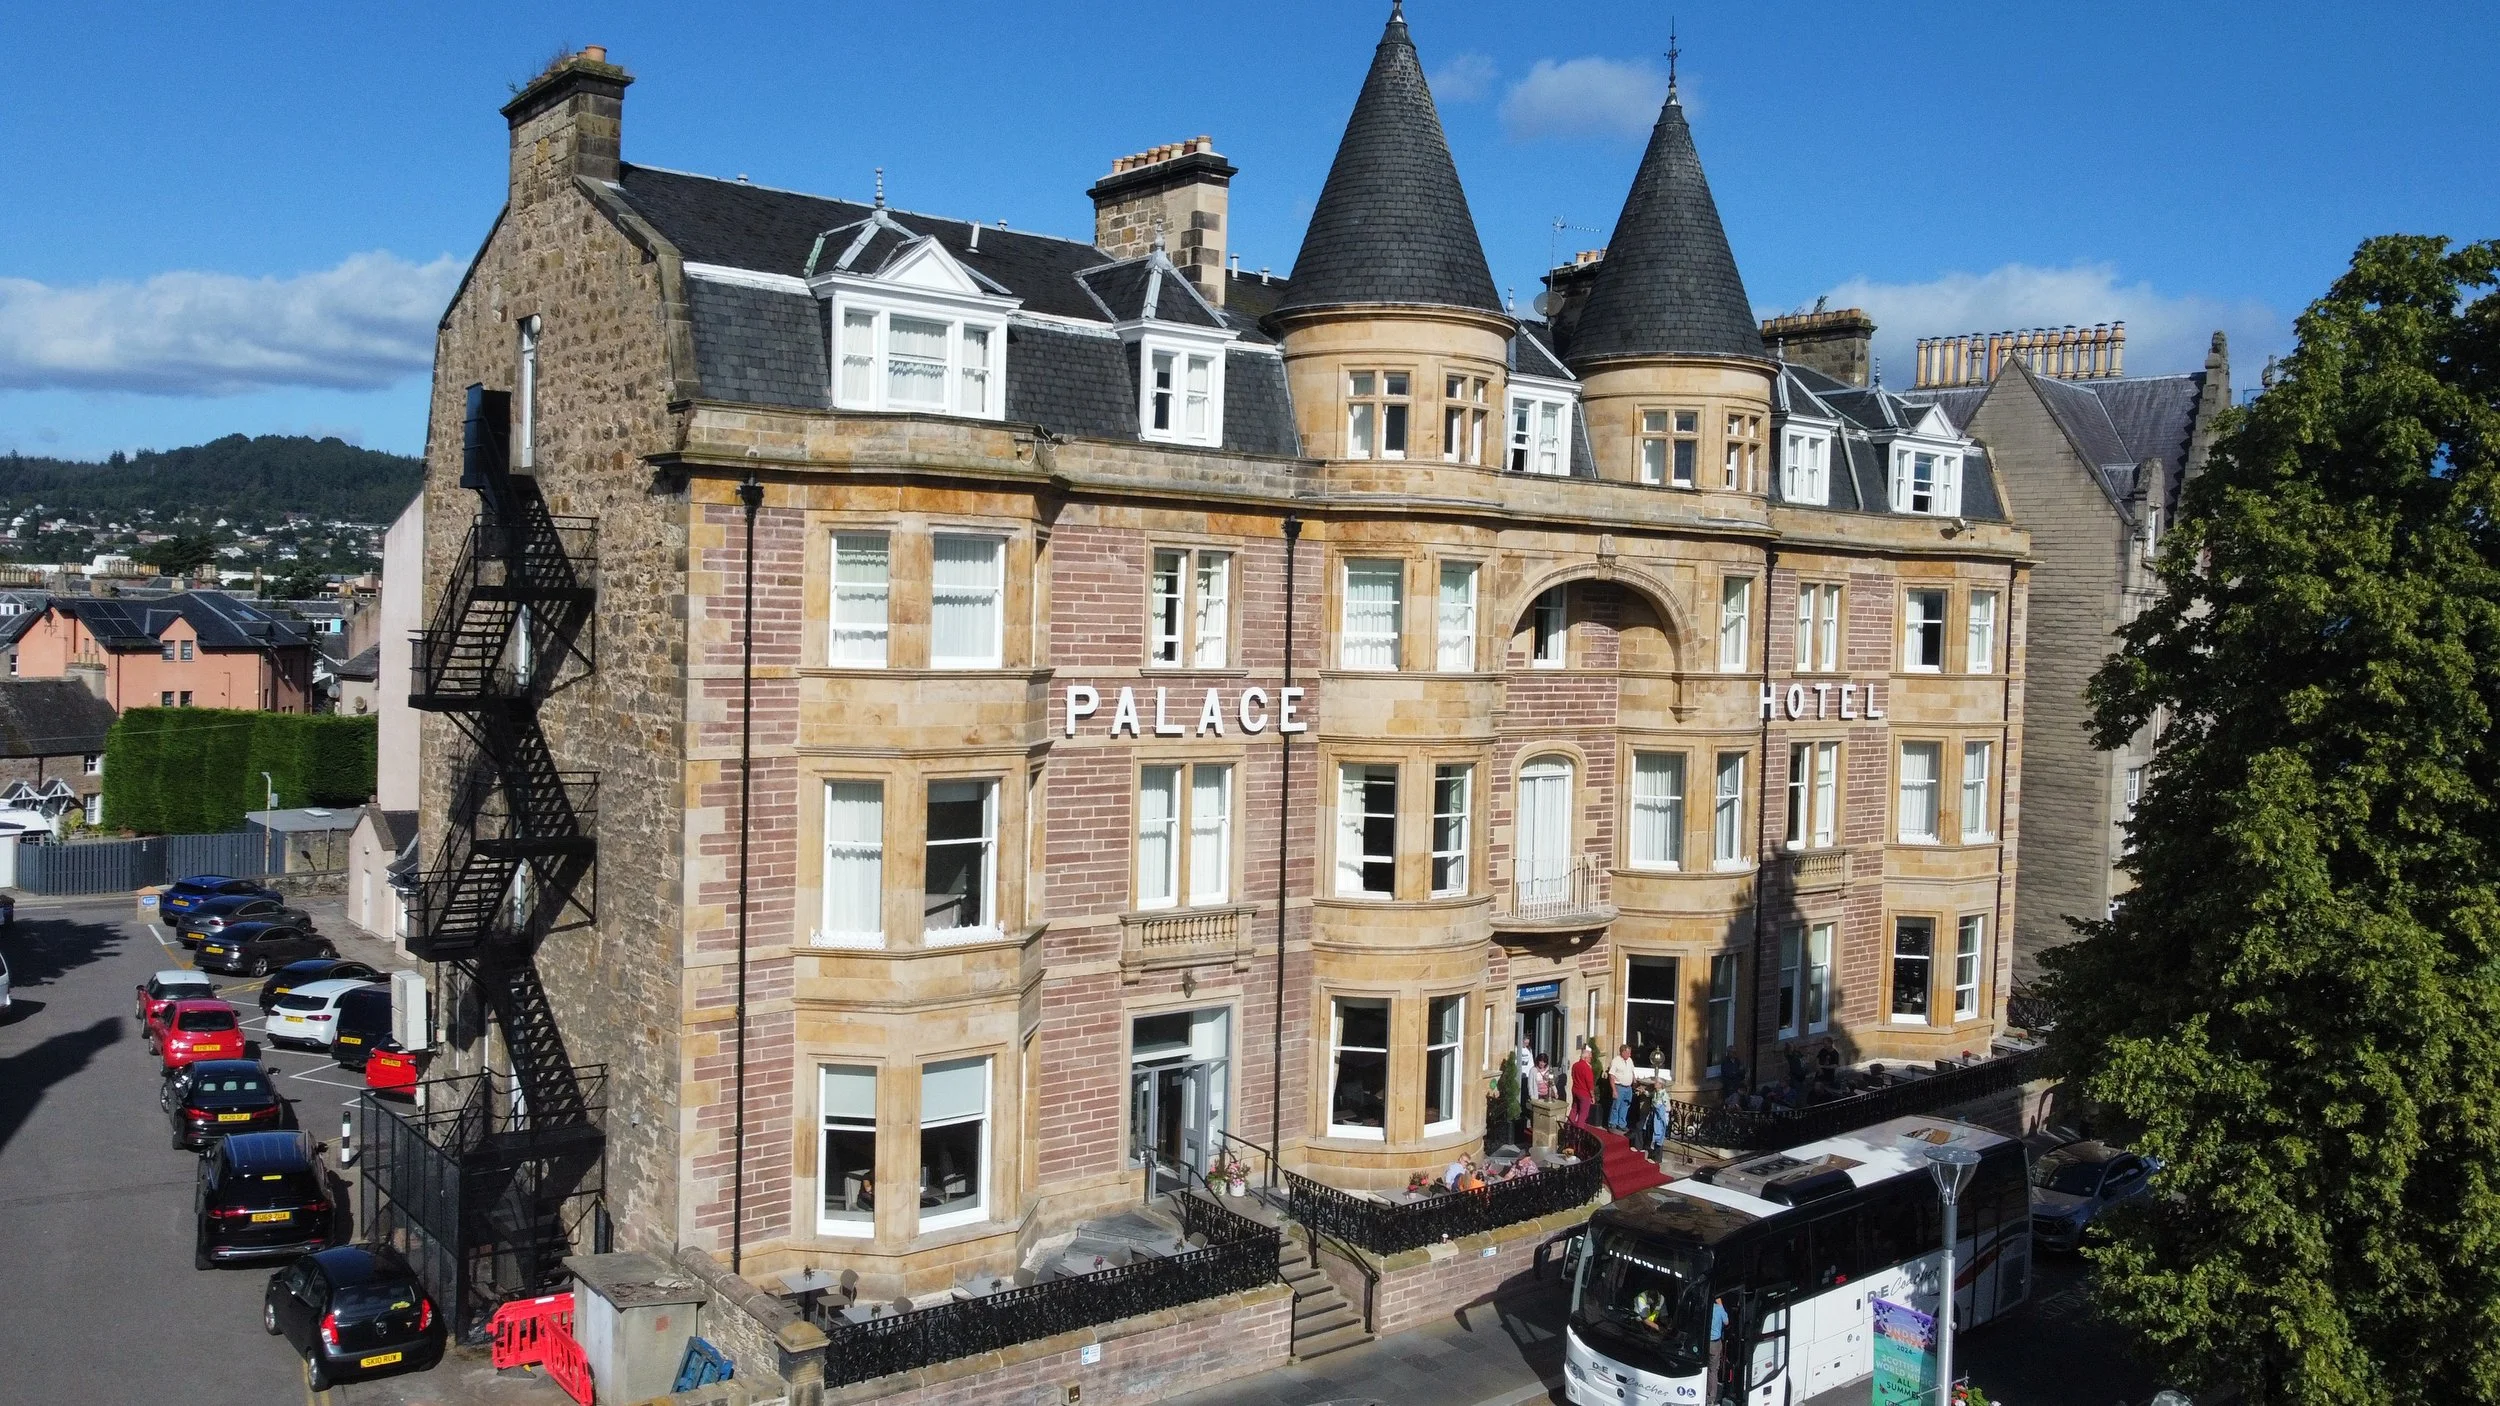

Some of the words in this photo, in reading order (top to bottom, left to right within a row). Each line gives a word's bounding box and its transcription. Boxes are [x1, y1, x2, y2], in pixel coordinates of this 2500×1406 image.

[1067, 685, 1307, 735] PALACE
[1760, 683, 1884, 719] HOTEL
[1891, 1265, 1940, 1297] Coaches
[1875, 1360, 1906, 1377] WORLD
[1626, 1377, 1669, 1397] Coaches
[1886, 1381, 1921, 1400] SUMMER
[1897, 1377, 1911, 1388] ALL
